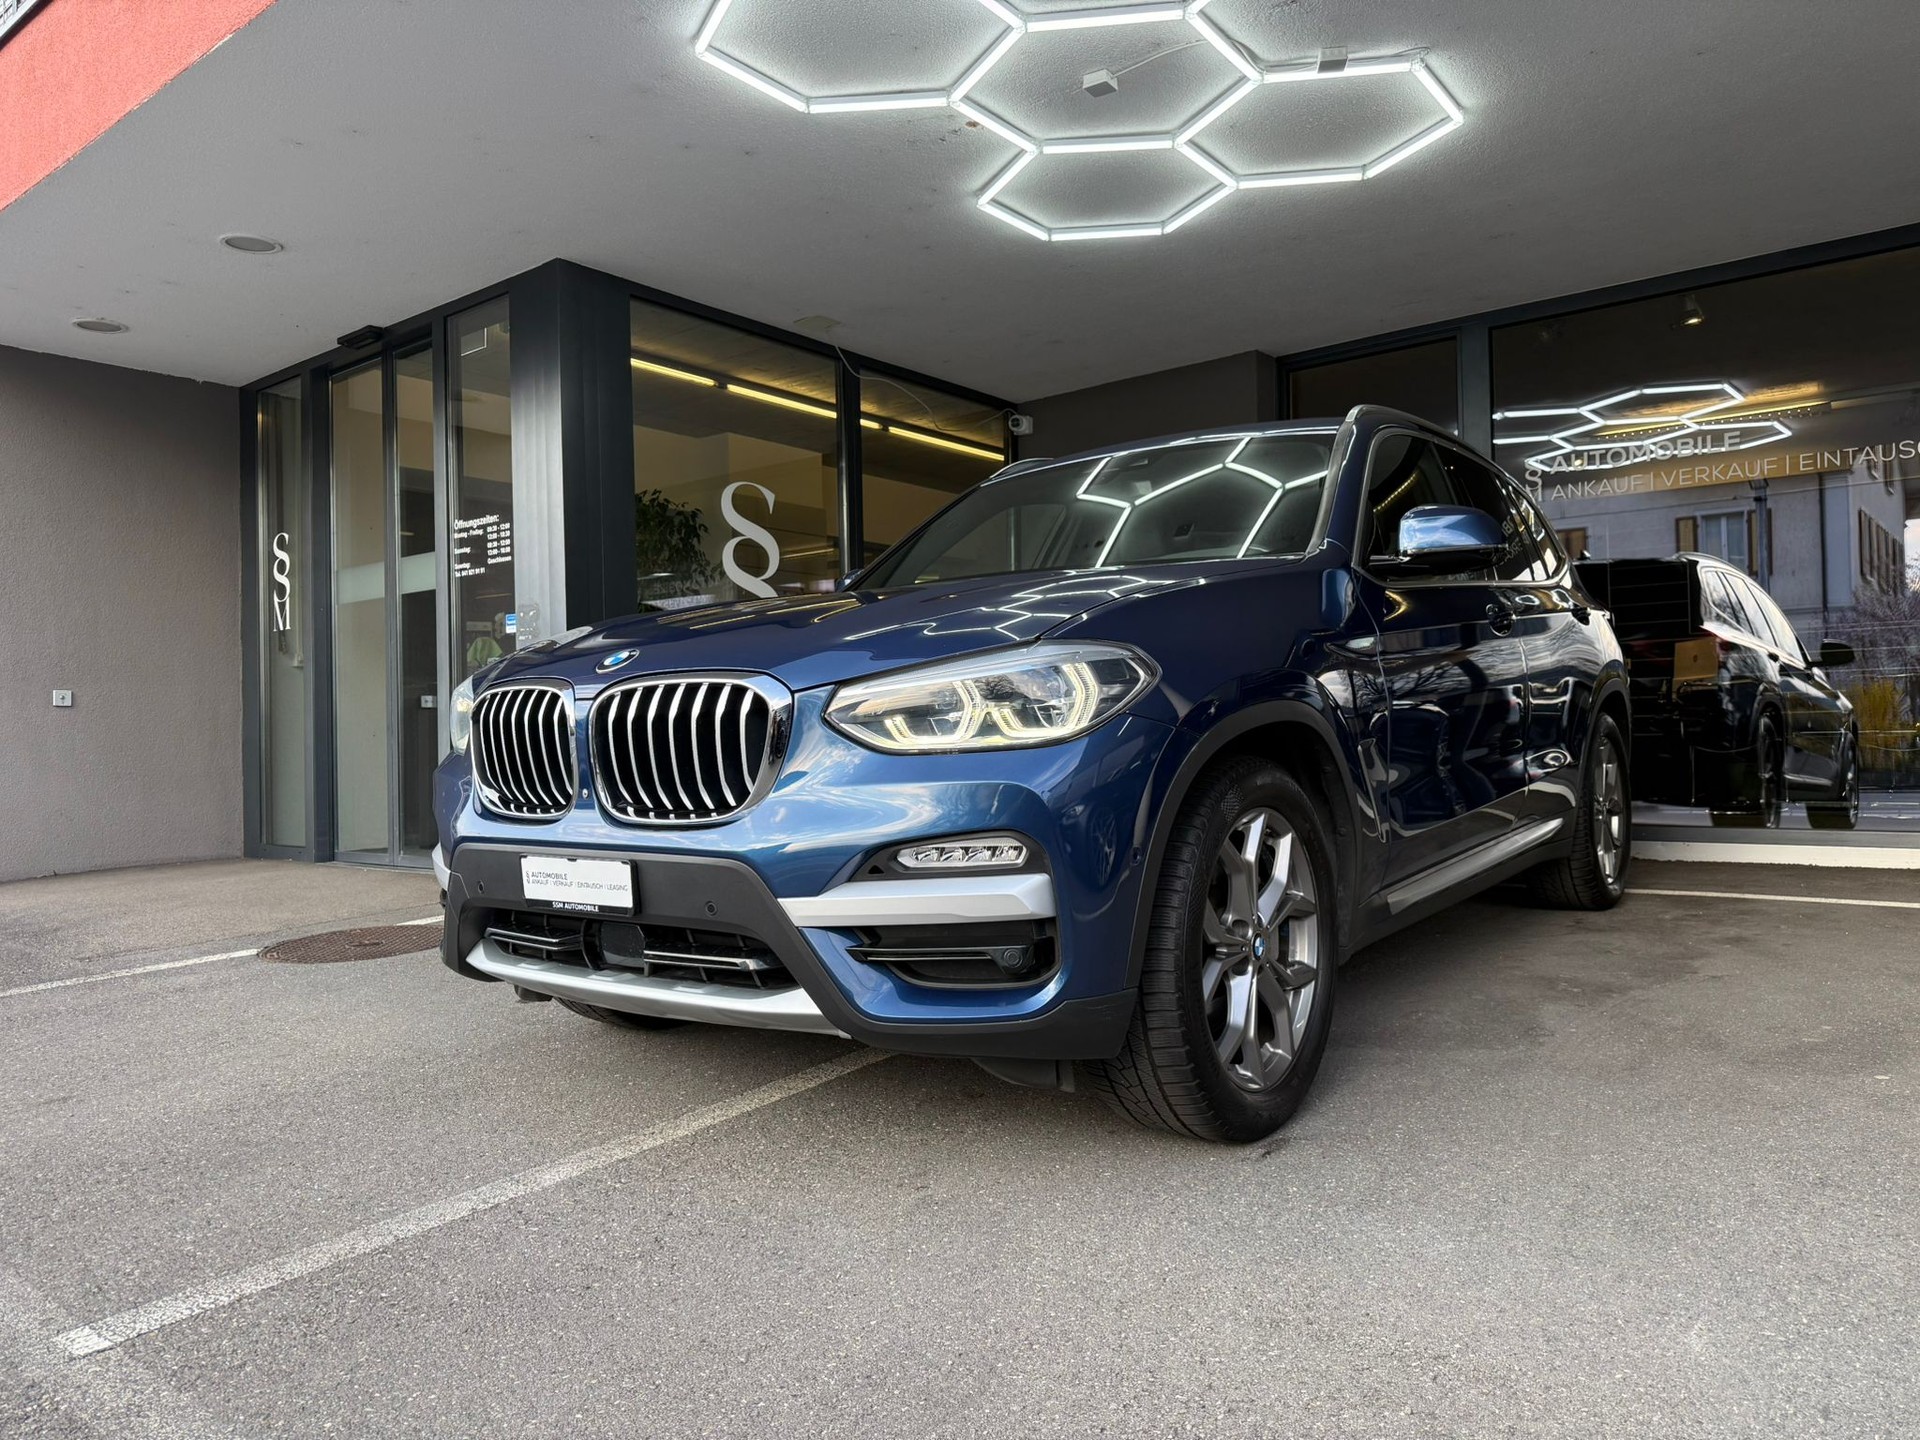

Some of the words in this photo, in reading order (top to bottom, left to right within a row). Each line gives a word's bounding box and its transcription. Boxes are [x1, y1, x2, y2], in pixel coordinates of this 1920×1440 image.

[1550, 431, 1741, 474] AUTOMOBILE
[1551, 474, 1643, 501] ANKAUF
[1660, 457, 1778, 487] VERKAUF
[1799, 440, 1920, 471] EINTAUS
[531, 871, 568, 881] AUTOMOBILE
[564, 902, 599, 912] AUTOMOBILE
